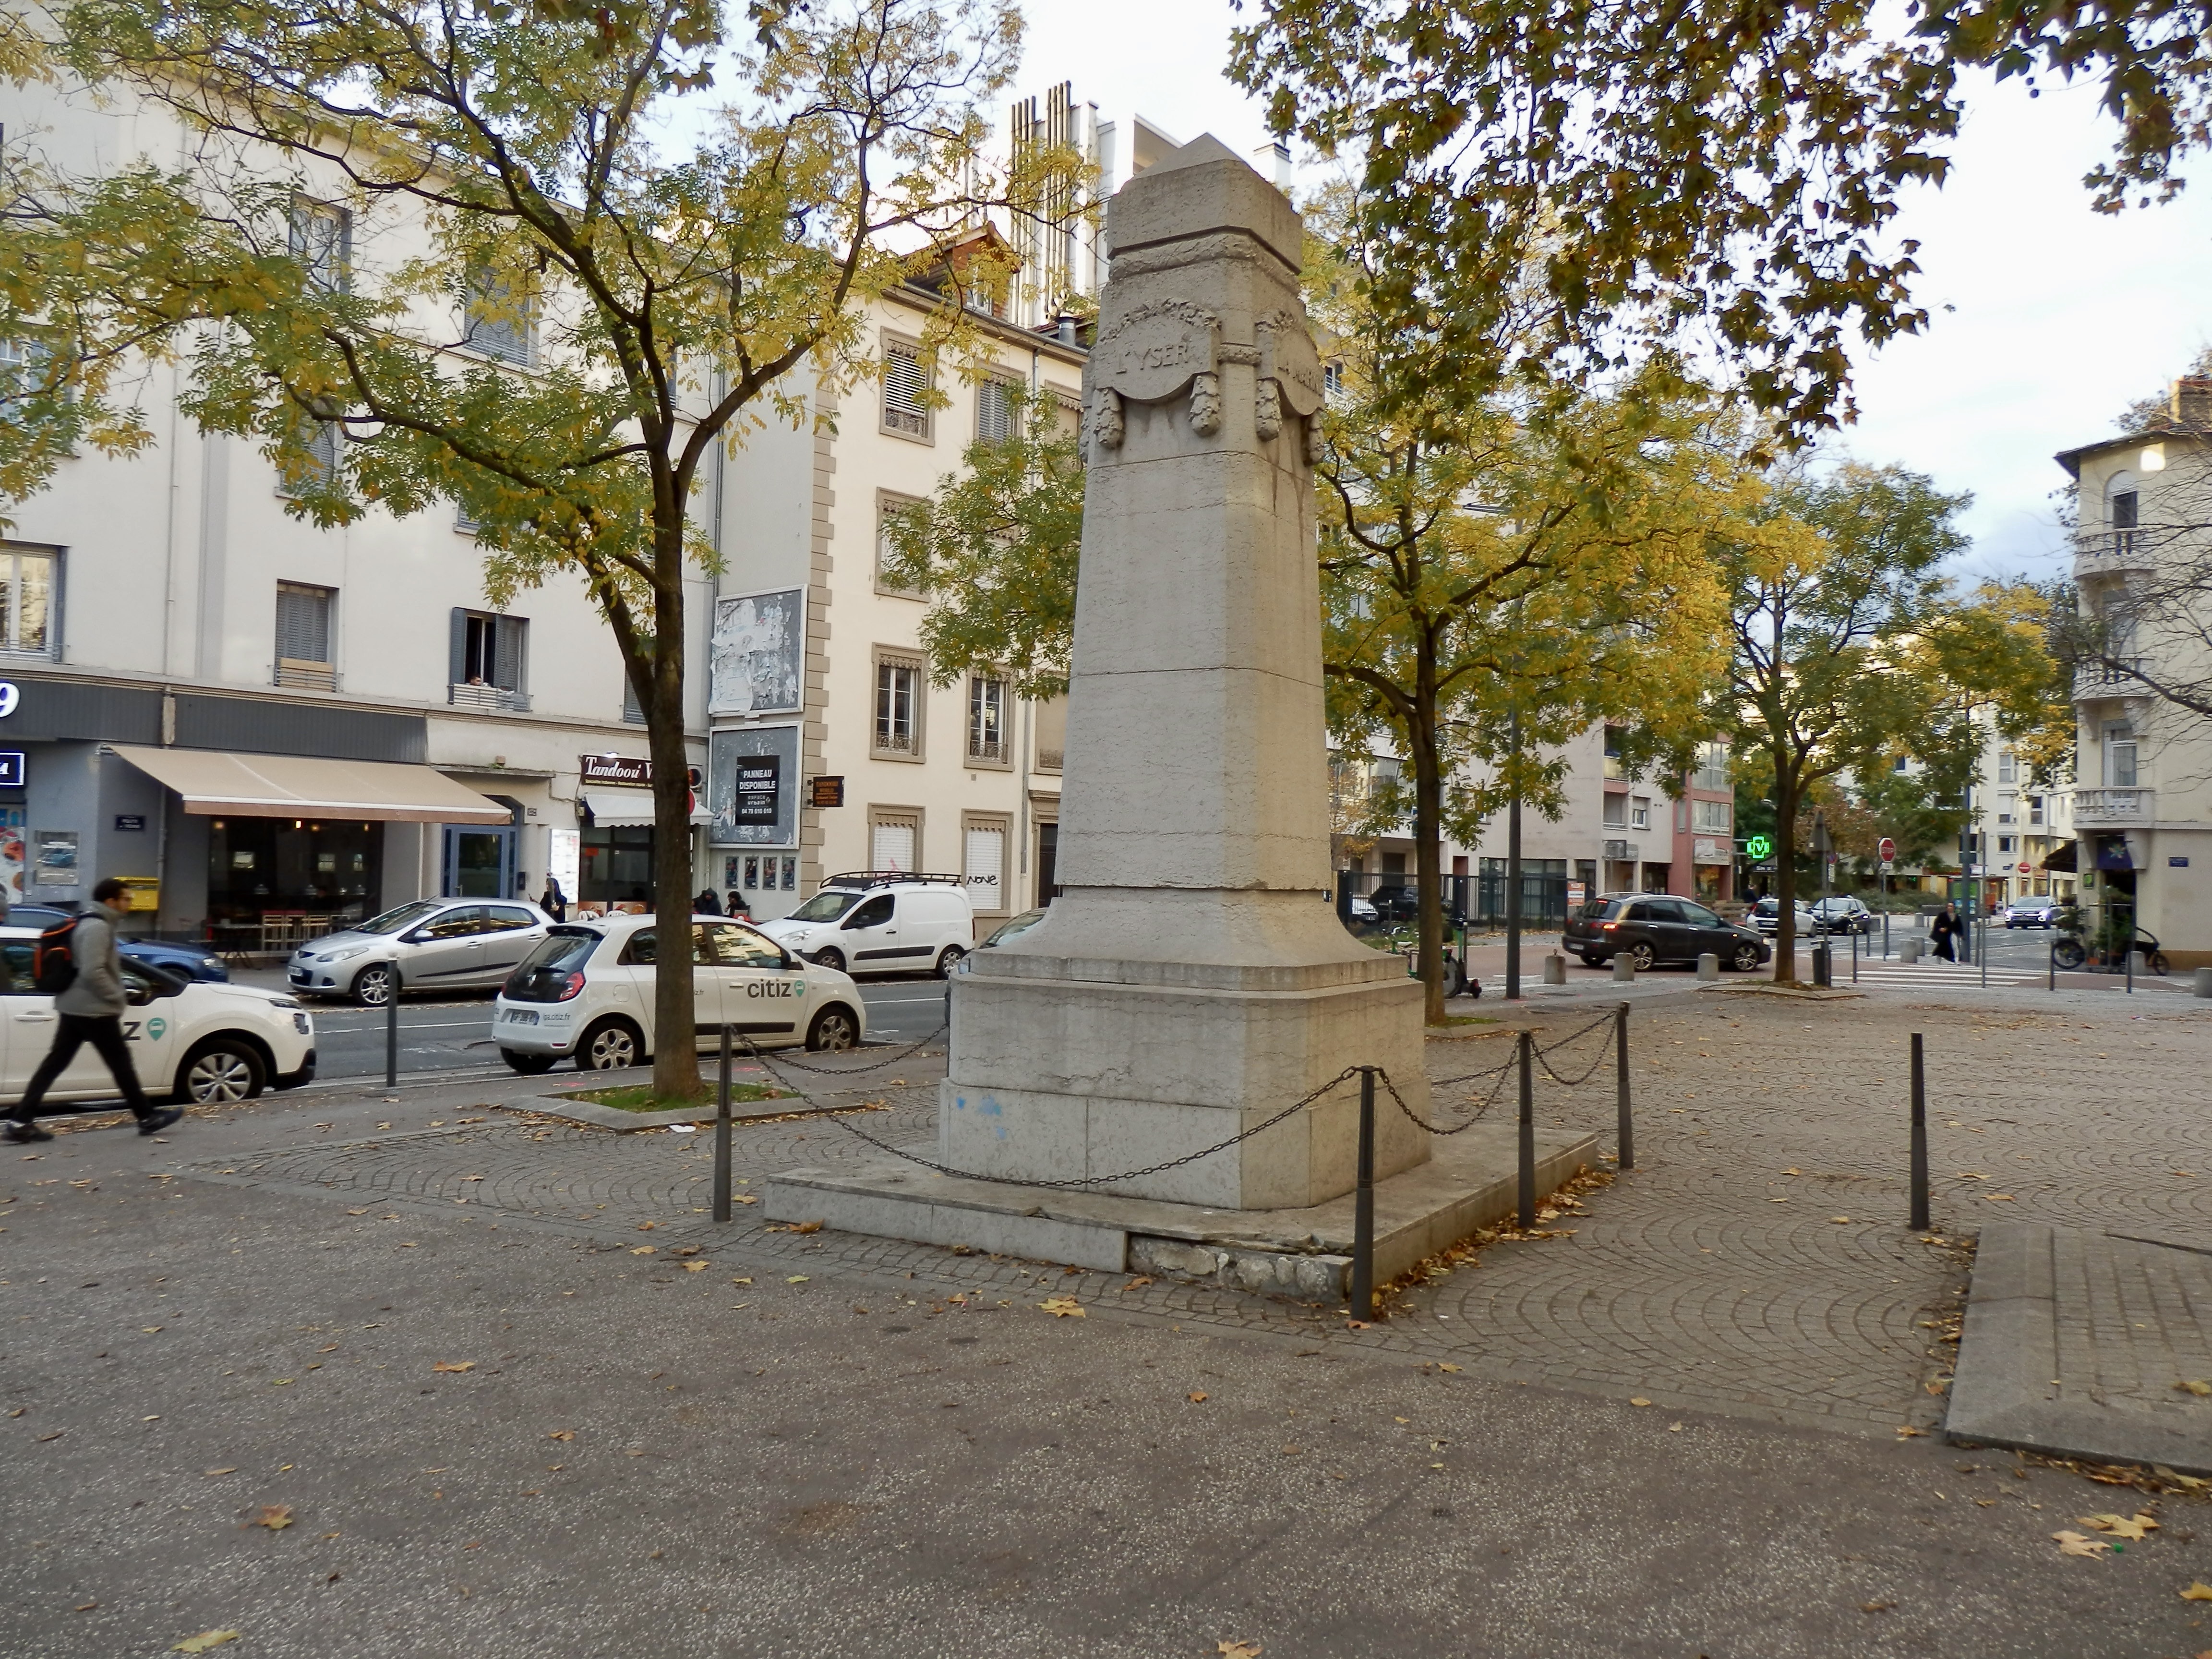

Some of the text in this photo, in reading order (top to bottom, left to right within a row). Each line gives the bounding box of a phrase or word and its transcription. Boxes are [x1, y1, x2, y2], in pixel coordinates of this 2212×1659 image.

[585, 756, 642, 779] Tandoori
[743, 769, 772, 779] PANNEAU
[739, 781, 776, 790] DISPONIBLE
[747, 978, 792, 998] citiz
